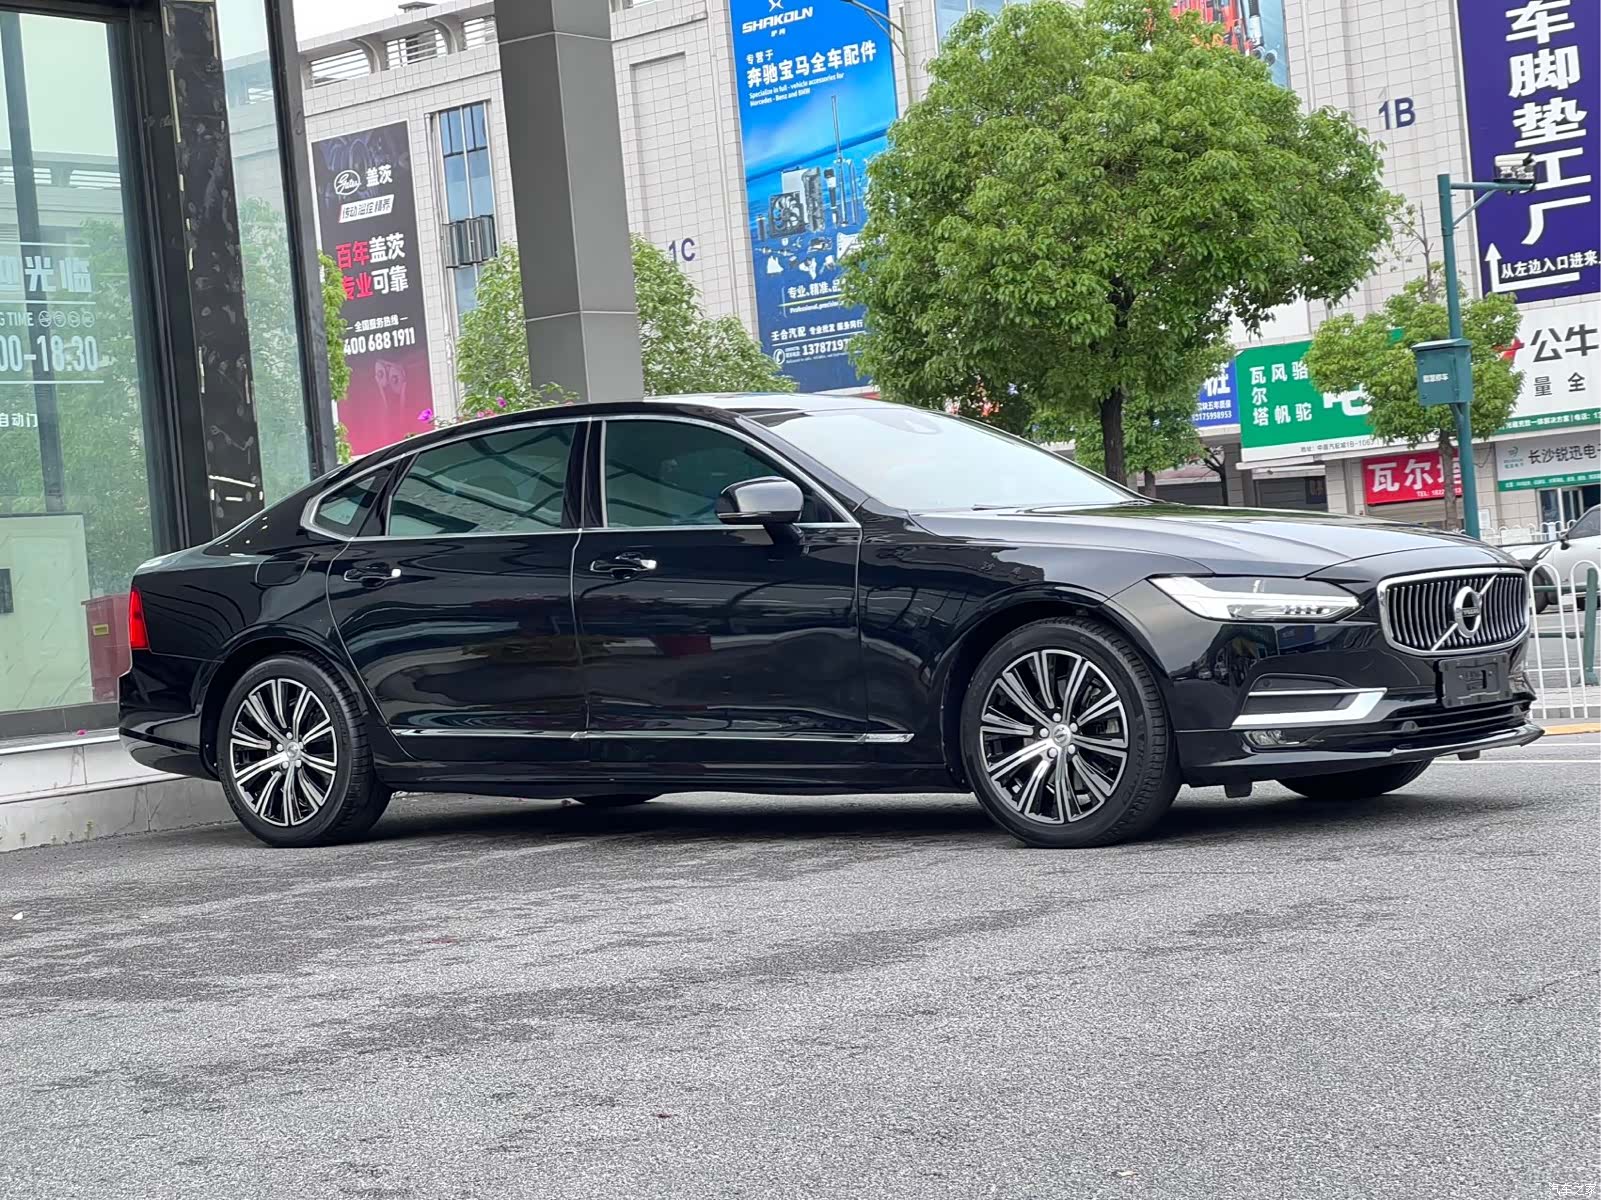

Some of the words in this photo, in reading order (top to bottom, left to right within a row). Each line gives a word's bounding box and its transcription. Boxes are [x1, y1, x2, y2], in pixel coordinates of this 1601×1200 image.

[742, 7, 813, 34] SHAKOLN
[746, 49, 774, 64] 专营于
[747, 40, 877, 88] 奔驰宝马全车配件
[1378, 97, 1416, 130] 1B
[366, 164, 393, 187] 盖茨
[336, 232, 406, 271] 百年盖茨
[668, 237, 696, 264] 1C
[1501, 250, 1601, 279] 从左边入口进来
[342, 265, 409, 301] 专业可靠
[788, 279, 846, 299] 专业、精准、品
[344, 336, 367, 356] 400
[368, 332, 392, 352] 688
[392, 326, 416, 347] 1911
[1530, 323, 1600, 362] 公牛
[1249, 366, 1269, 426] 瓦尔塔
[1272, 363, 1291, 424] 风帆
[1534, 375, 1552, 397] 量
[1567, 372, 1586, 393] 全
[0, 413, 38, 428] 自动门
[1528, 443, 1601, 464] 长沙锐迅电
